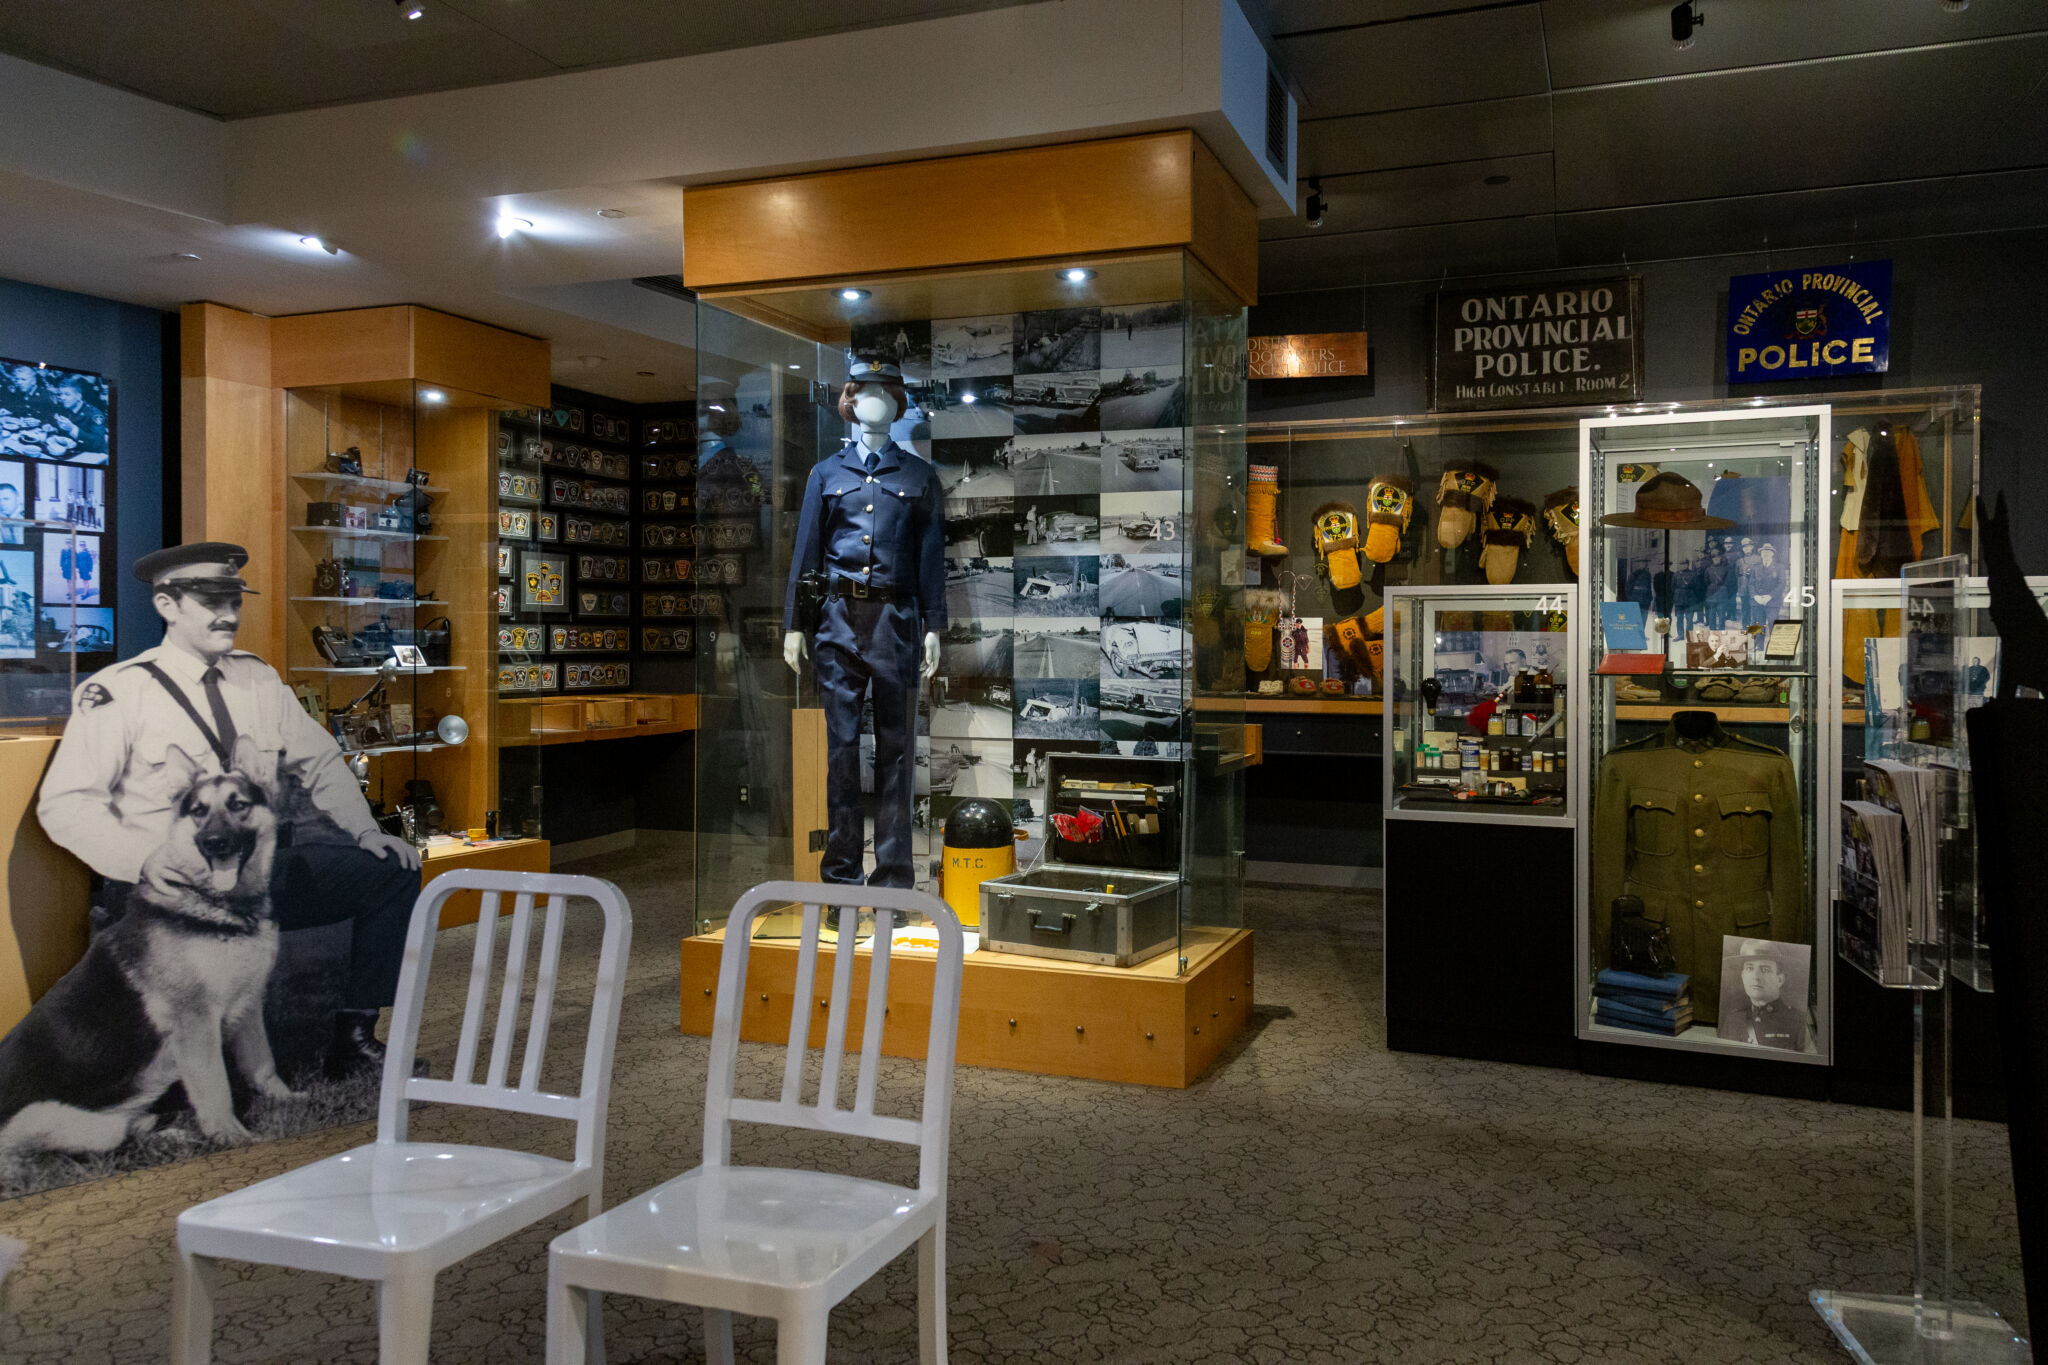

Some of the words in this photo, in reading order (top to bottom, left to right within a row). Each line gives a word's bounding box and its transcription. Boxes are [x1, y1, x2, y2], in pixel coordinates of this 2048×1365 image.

[1461, 288, 1613, 323] ONTARIO
[1733, 279, 1793, 335] ONTARIO
[1802, 273, 1883, 325] PROVINCIAL
[1454, 316, 1633, 352] PROVINCIAL
[1474, 348, 1601, 379] POLICE.
[1738, 337, 1875, 372] POLICE
[1456, 385, 1486, 399] HIGH
[1576, 377, 1616, 391] ROOM
[1619, 374, 1630, 389] 2
[1150, 520, 1175, 541] 43
[1535, 595, 1563, 614] 44
[1783, 586, 1815, 607] 45
[710, 631, 716, 641] 9
